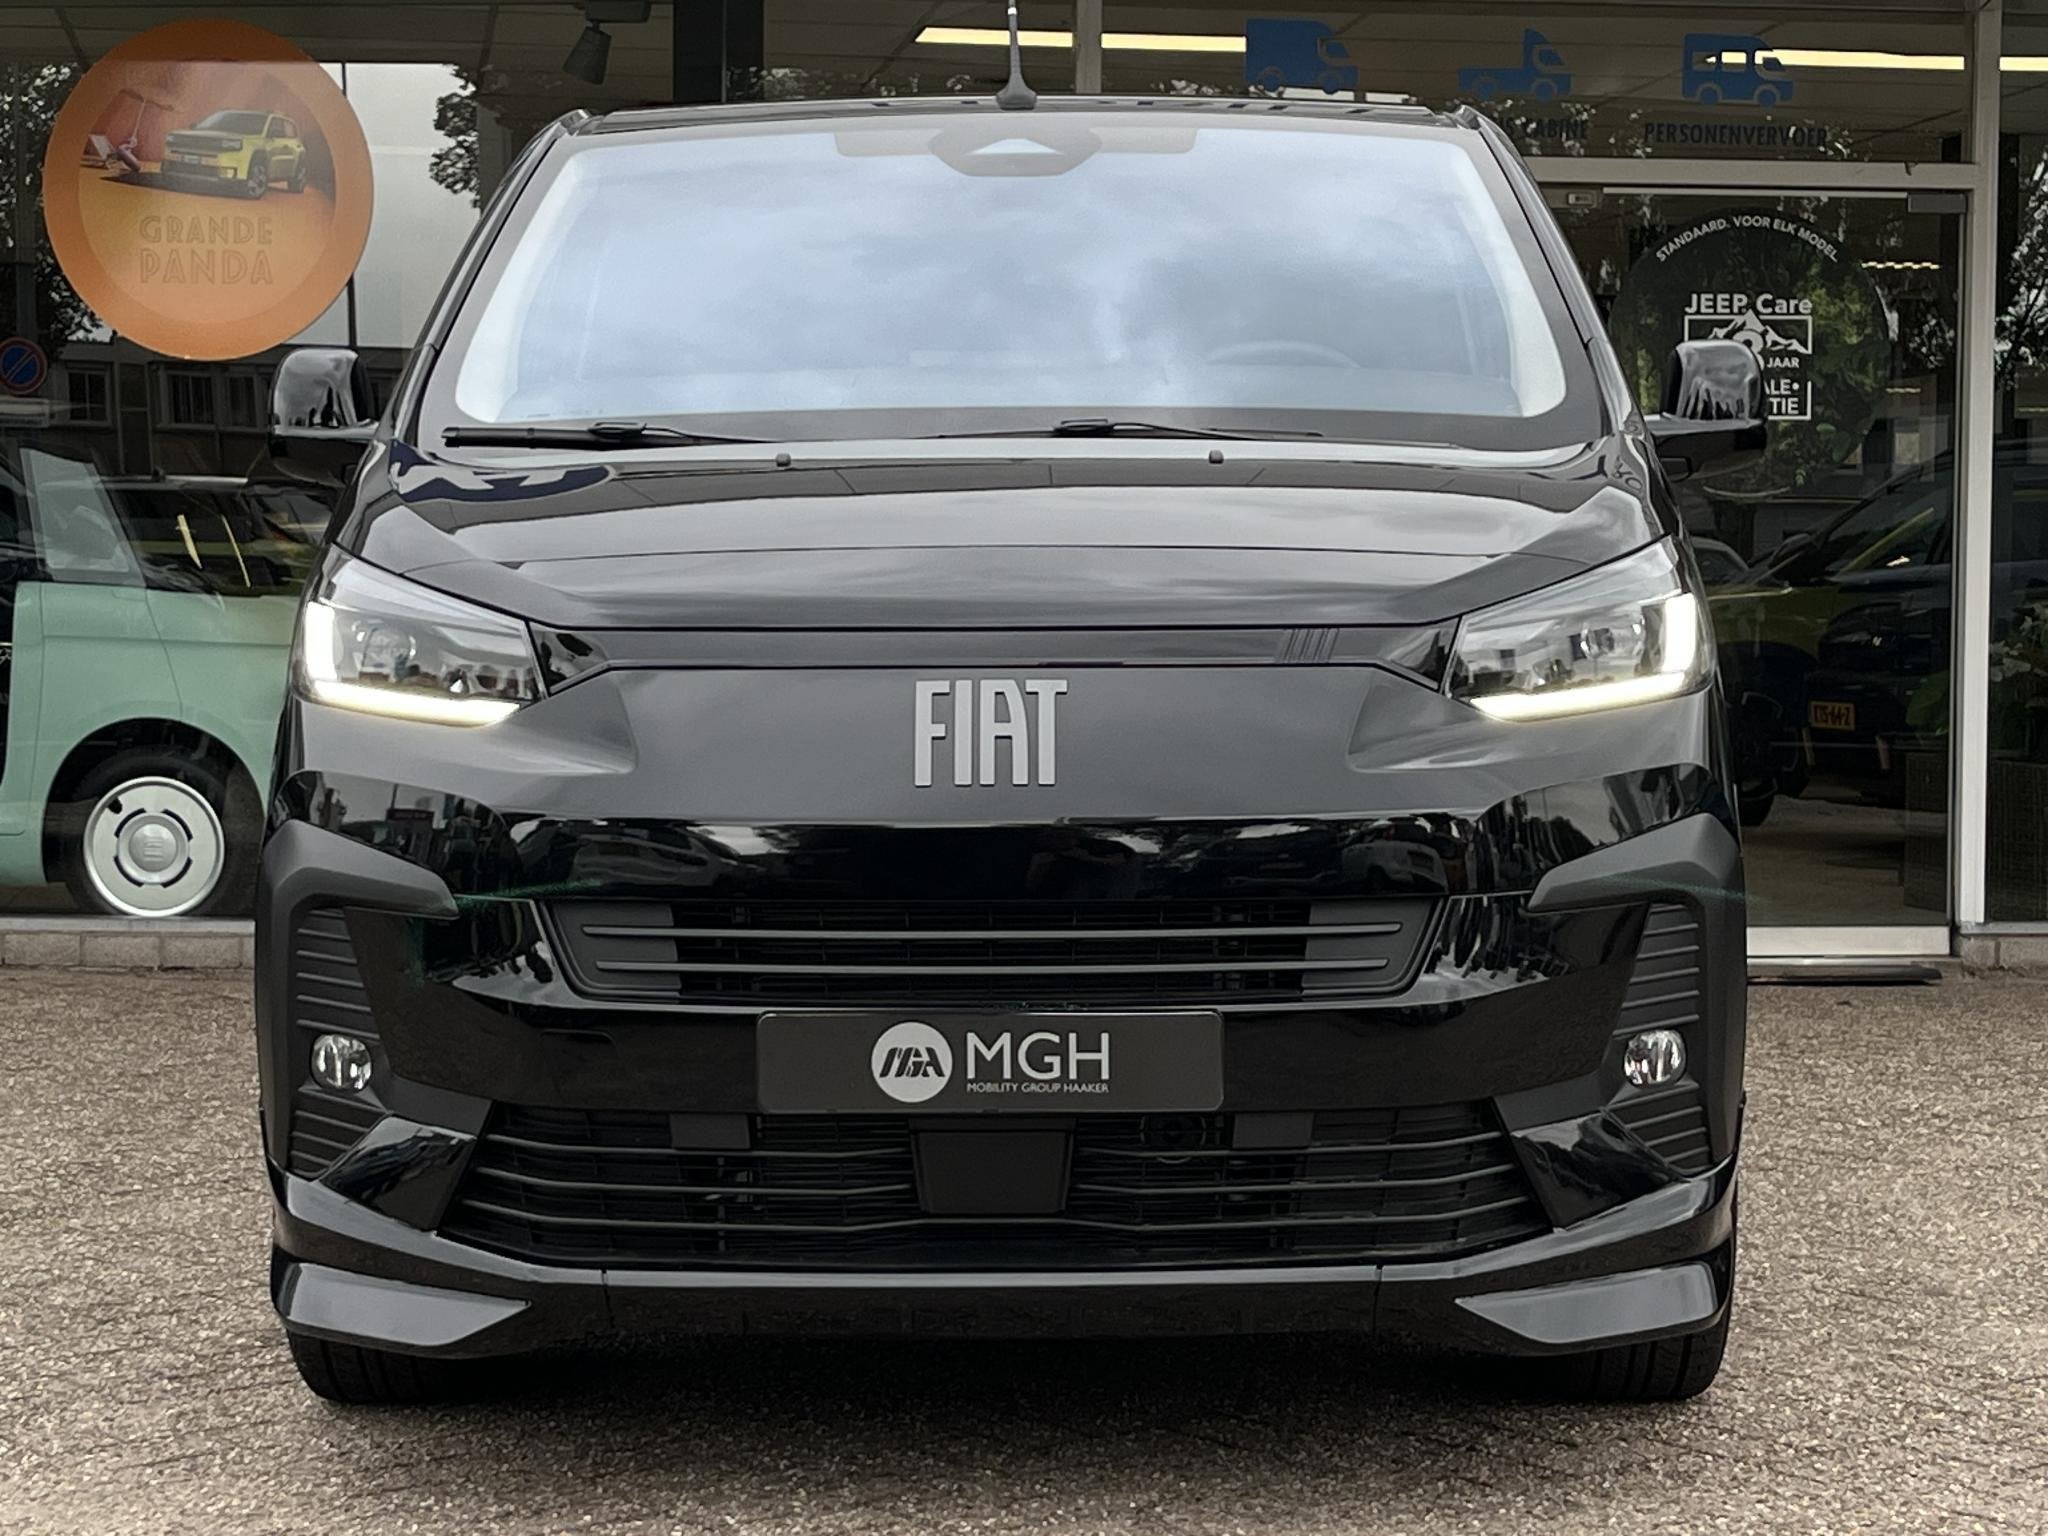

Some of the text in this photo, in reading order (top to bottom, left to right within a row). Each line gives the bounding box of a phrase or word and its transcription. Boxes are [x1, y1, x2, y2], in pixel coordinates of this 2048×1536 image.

[1643, 121, 1827, 147] PERSONENVERVOER
[139, 215, 273, 245] GRANDE
[1732, 215, 1771, 229] VOOR
[1773, 218, 1797, 235] ELK
[140, 249, 273, 285] PANDA
[1756, 293, 1813, 314] Care
[1766, 356, 1800, 368] JAAR
[914, 679, 1068, 788] FIAT
[966, 1032, 1110, 1080] MGH
[966, 1082, 1110, 1093] MOBILITY GROUP HAAKER
